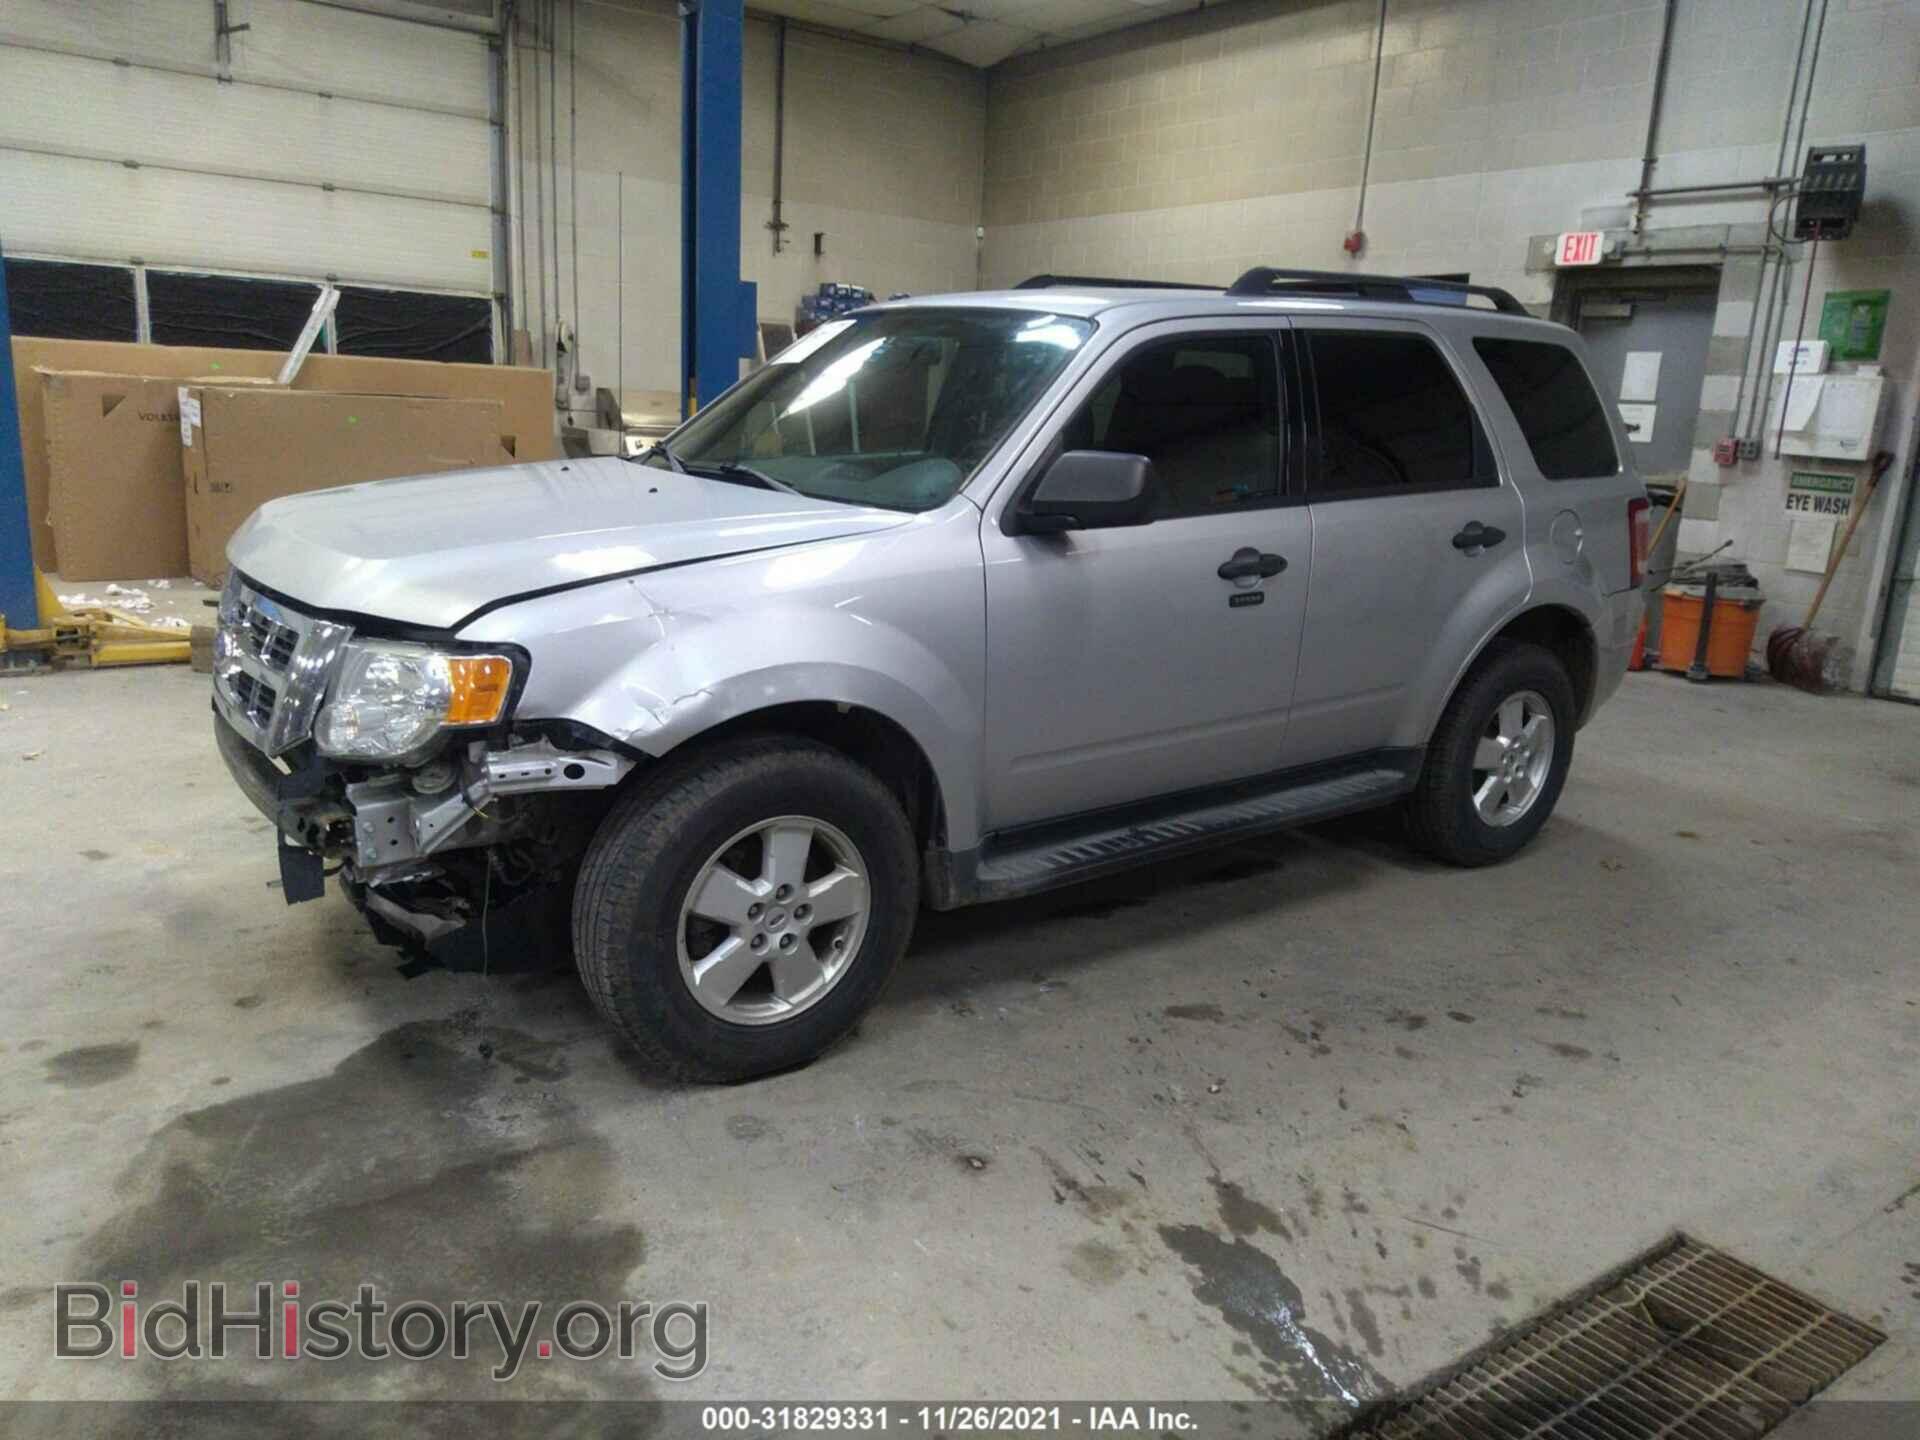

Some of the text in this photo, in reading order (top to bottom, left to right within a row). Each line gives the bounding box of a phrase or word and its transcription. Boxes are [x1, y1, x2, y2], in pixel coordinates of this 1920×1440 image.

[1563, 233, 1600, 262] EXIT
[1785, 493, 1851, 515] EYE WASH
